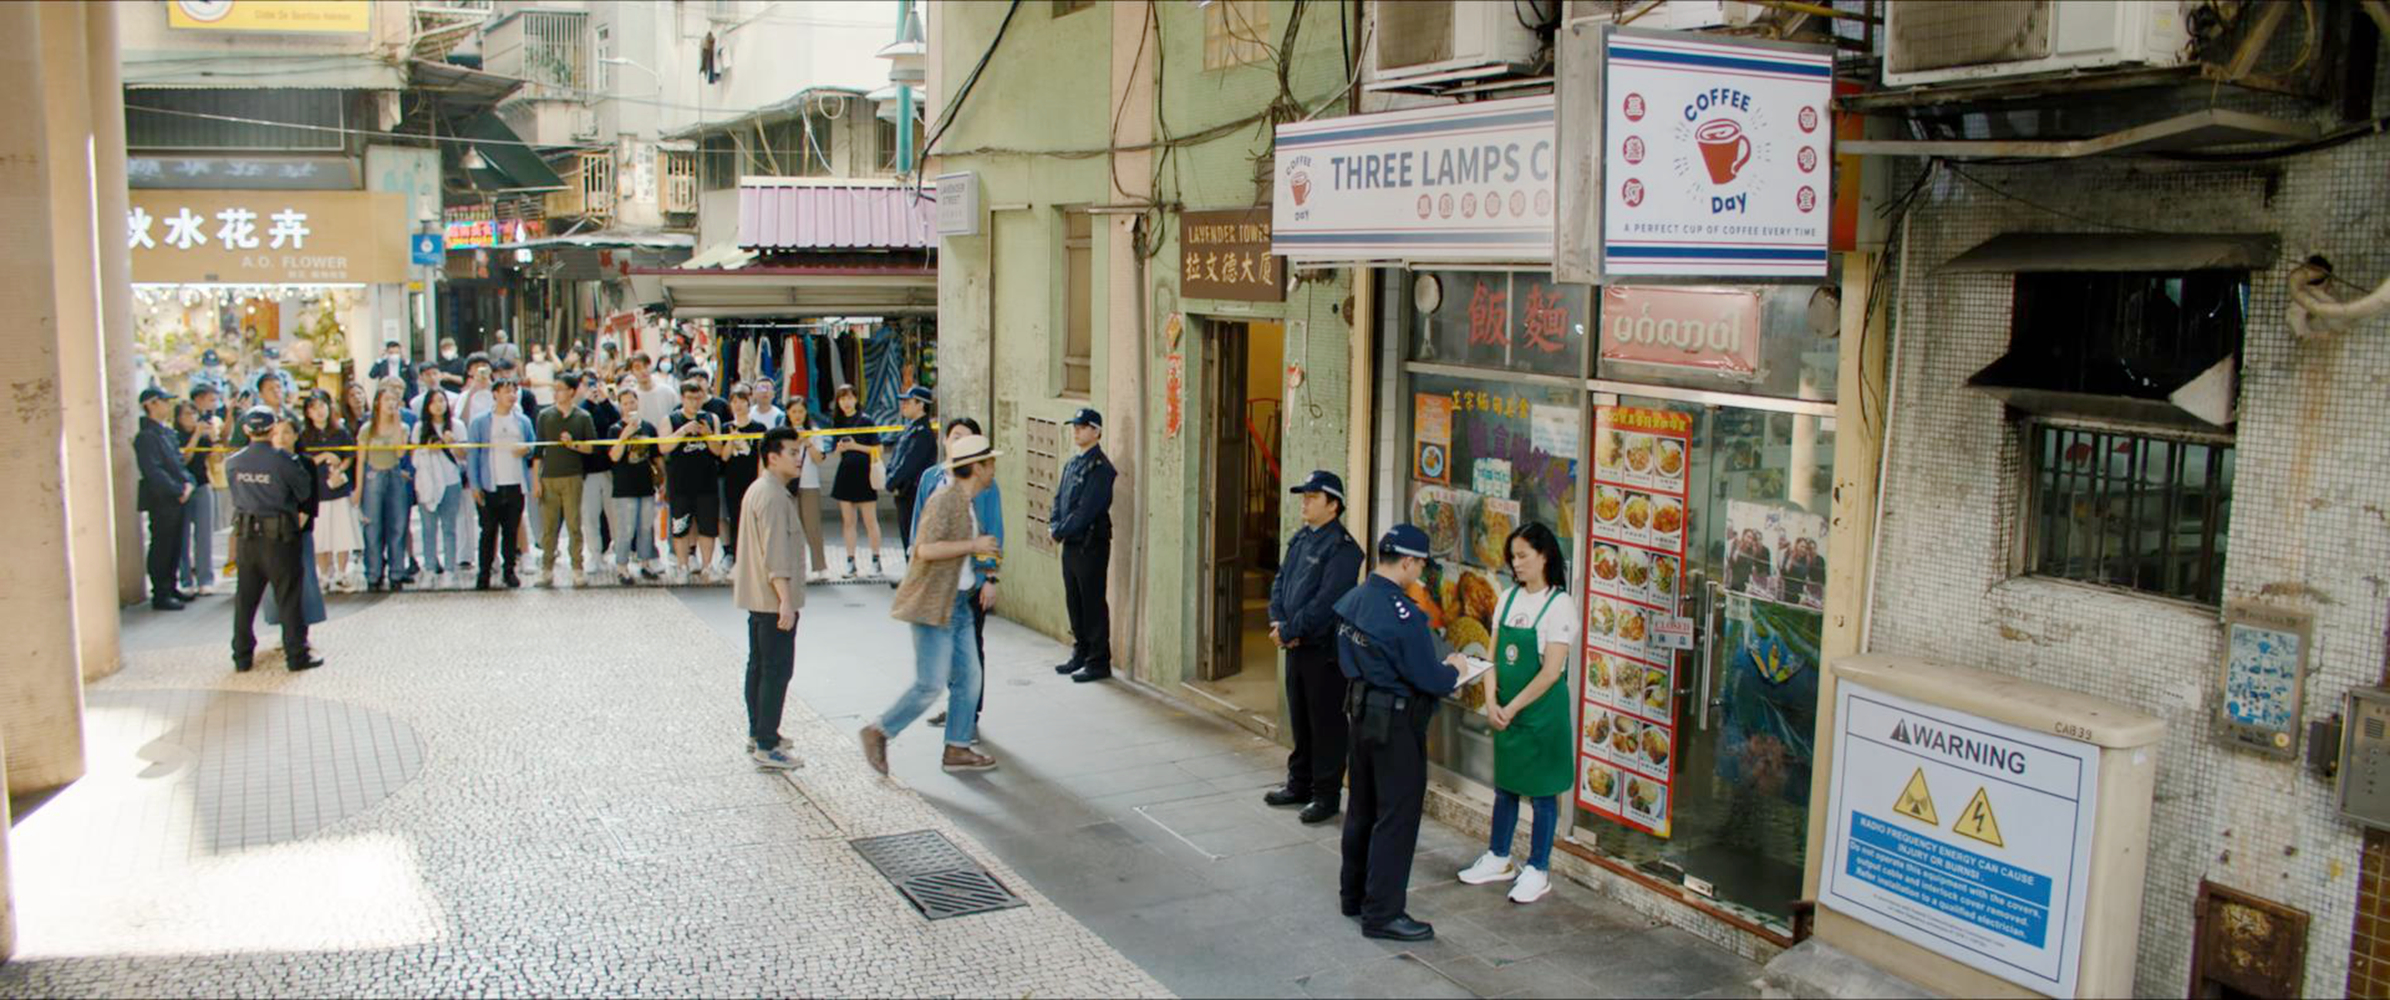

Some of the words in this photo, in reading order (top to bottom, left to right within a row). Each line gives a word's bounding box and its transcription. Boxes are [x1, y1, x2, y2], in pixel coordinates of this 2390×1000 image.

[1685, 88, 1750, 121] COFFEE
[1286, 155, 1312, 176] COFFEE
[1331, 151, 1413, 191] THREE
[1422, 146, 1520, 186] LAMPS
[1634, 224, 1679, 234] PERFECT
[1683, 225, 1702, 234] CUP
[1706, 225, 1719, 235] OF
[1722, 225, 1759, 236] COFFEE
[1762, 226, 1791, 237] EVERY
[1794, 227, 1816, 237] TIME
[282, 256, 347, 269] FLOWER
[237, 472, 271, 485] POLICE
[2055, 722, 2093, 741] CAB39
[1913, 723, 2026, 776] WARNING
[1860, 817, 1885, 834] RADIO
[1886, 826, 1938, 852] FREQUENCY
[1938, 844, 1976, 865] ENERGY
[1977, 858, 1998, 873] CAN
[1999, 865, 2034, 886] CAUSE
[1897, 843, 1928, 861] INJURY
[1930, 854, 1943, 866] OR
[1856, 856, 1881, 875] output
[1882, 866, 1902, 880] cable
[1904, 874, 1920, 887] and
[1921, 880, 1958, 901] interlock
[1959, 894, 1985, 911] cover
[1861, 845, 1874, 858] not
[1874, 850, 1904, 871] operate
[1905, 861, 1921, 875] this
[1922, 868, 1967, 894] equipment
[1969, 884, 1988, 900] with
[1989, 892, 2005, 906] the
[1877, 875, 1919, 899] installation
[1938, 898, 1975, 921] qualified
